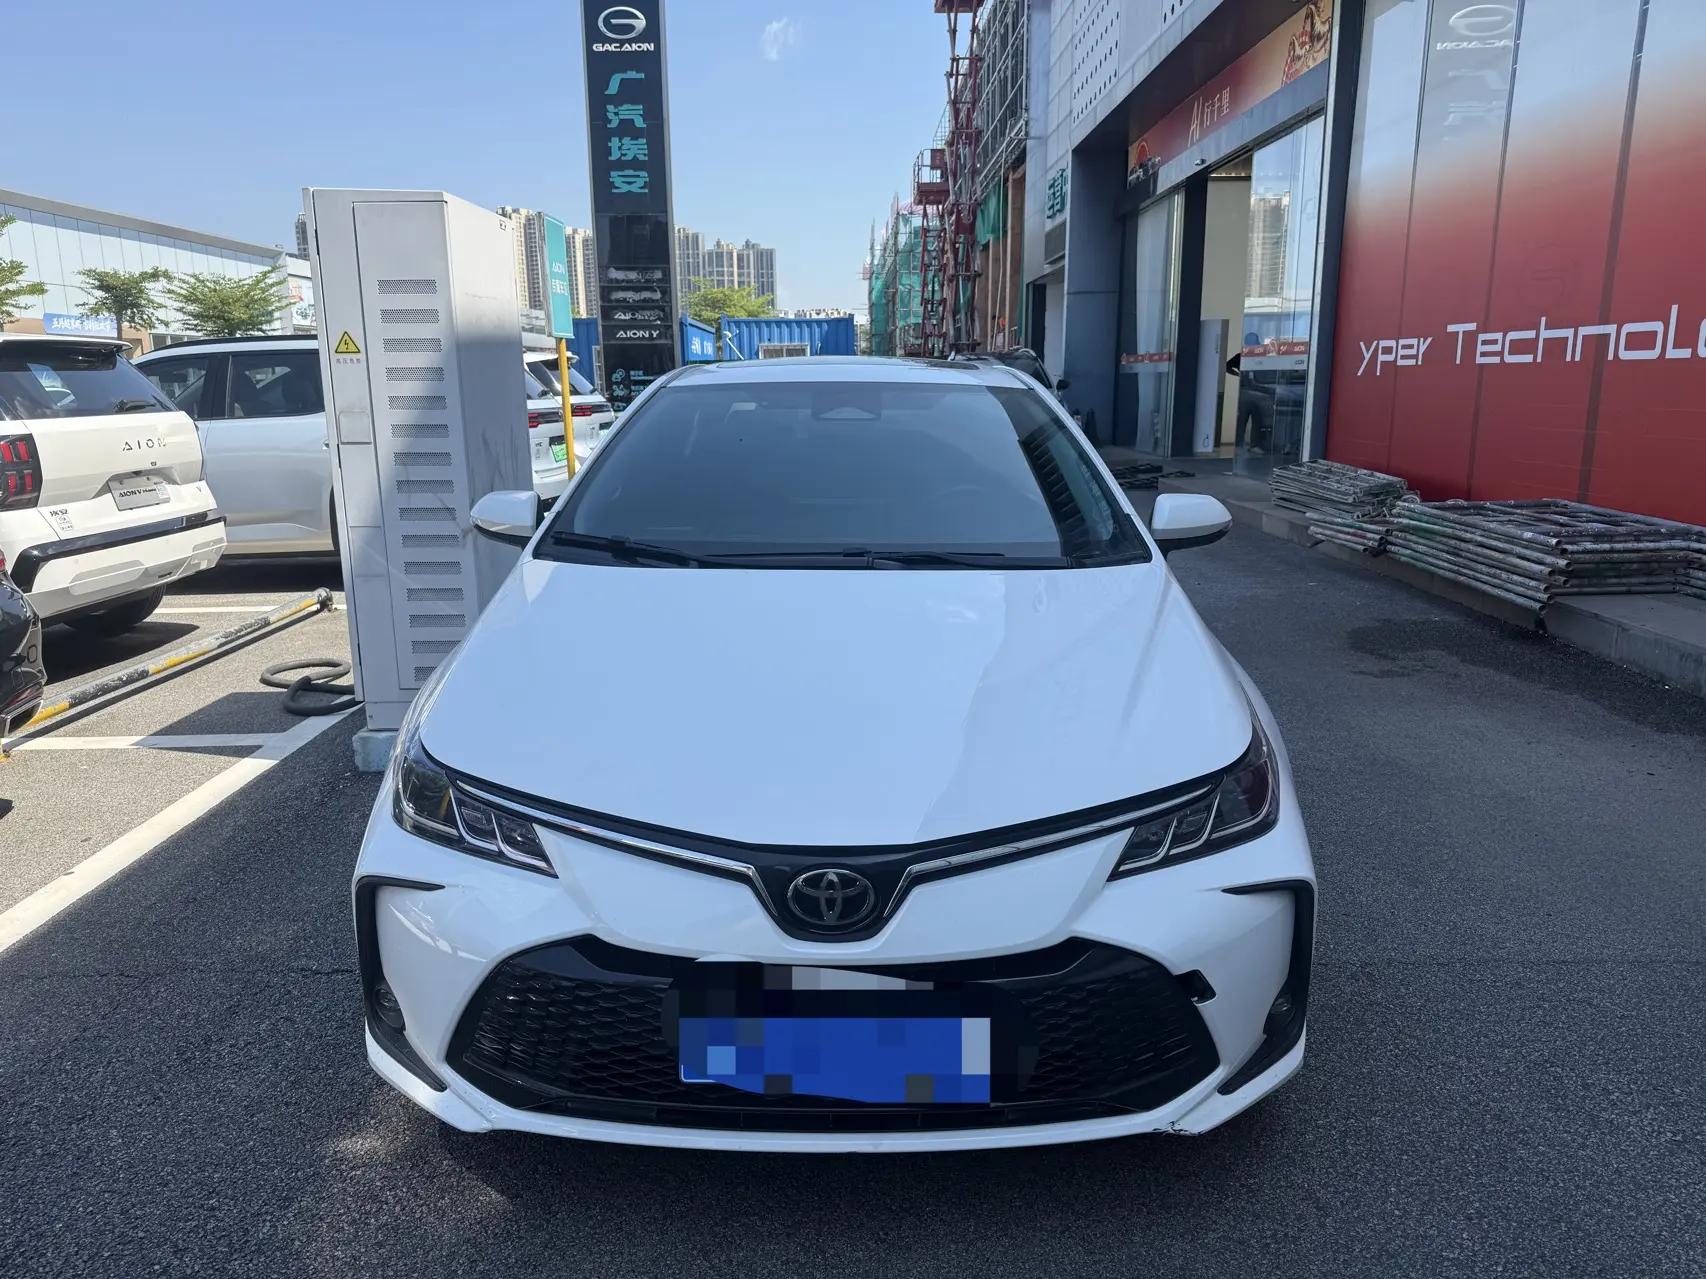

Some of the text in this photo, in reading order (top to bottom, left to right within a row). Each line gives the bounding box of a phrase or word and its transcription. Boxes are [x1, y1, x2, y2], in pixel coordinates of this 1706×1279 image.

[604, 70, 649, 193] 广汽埃安
[616, 330, 660, 338] AION Y
[122, 438, 167, 452] AION
